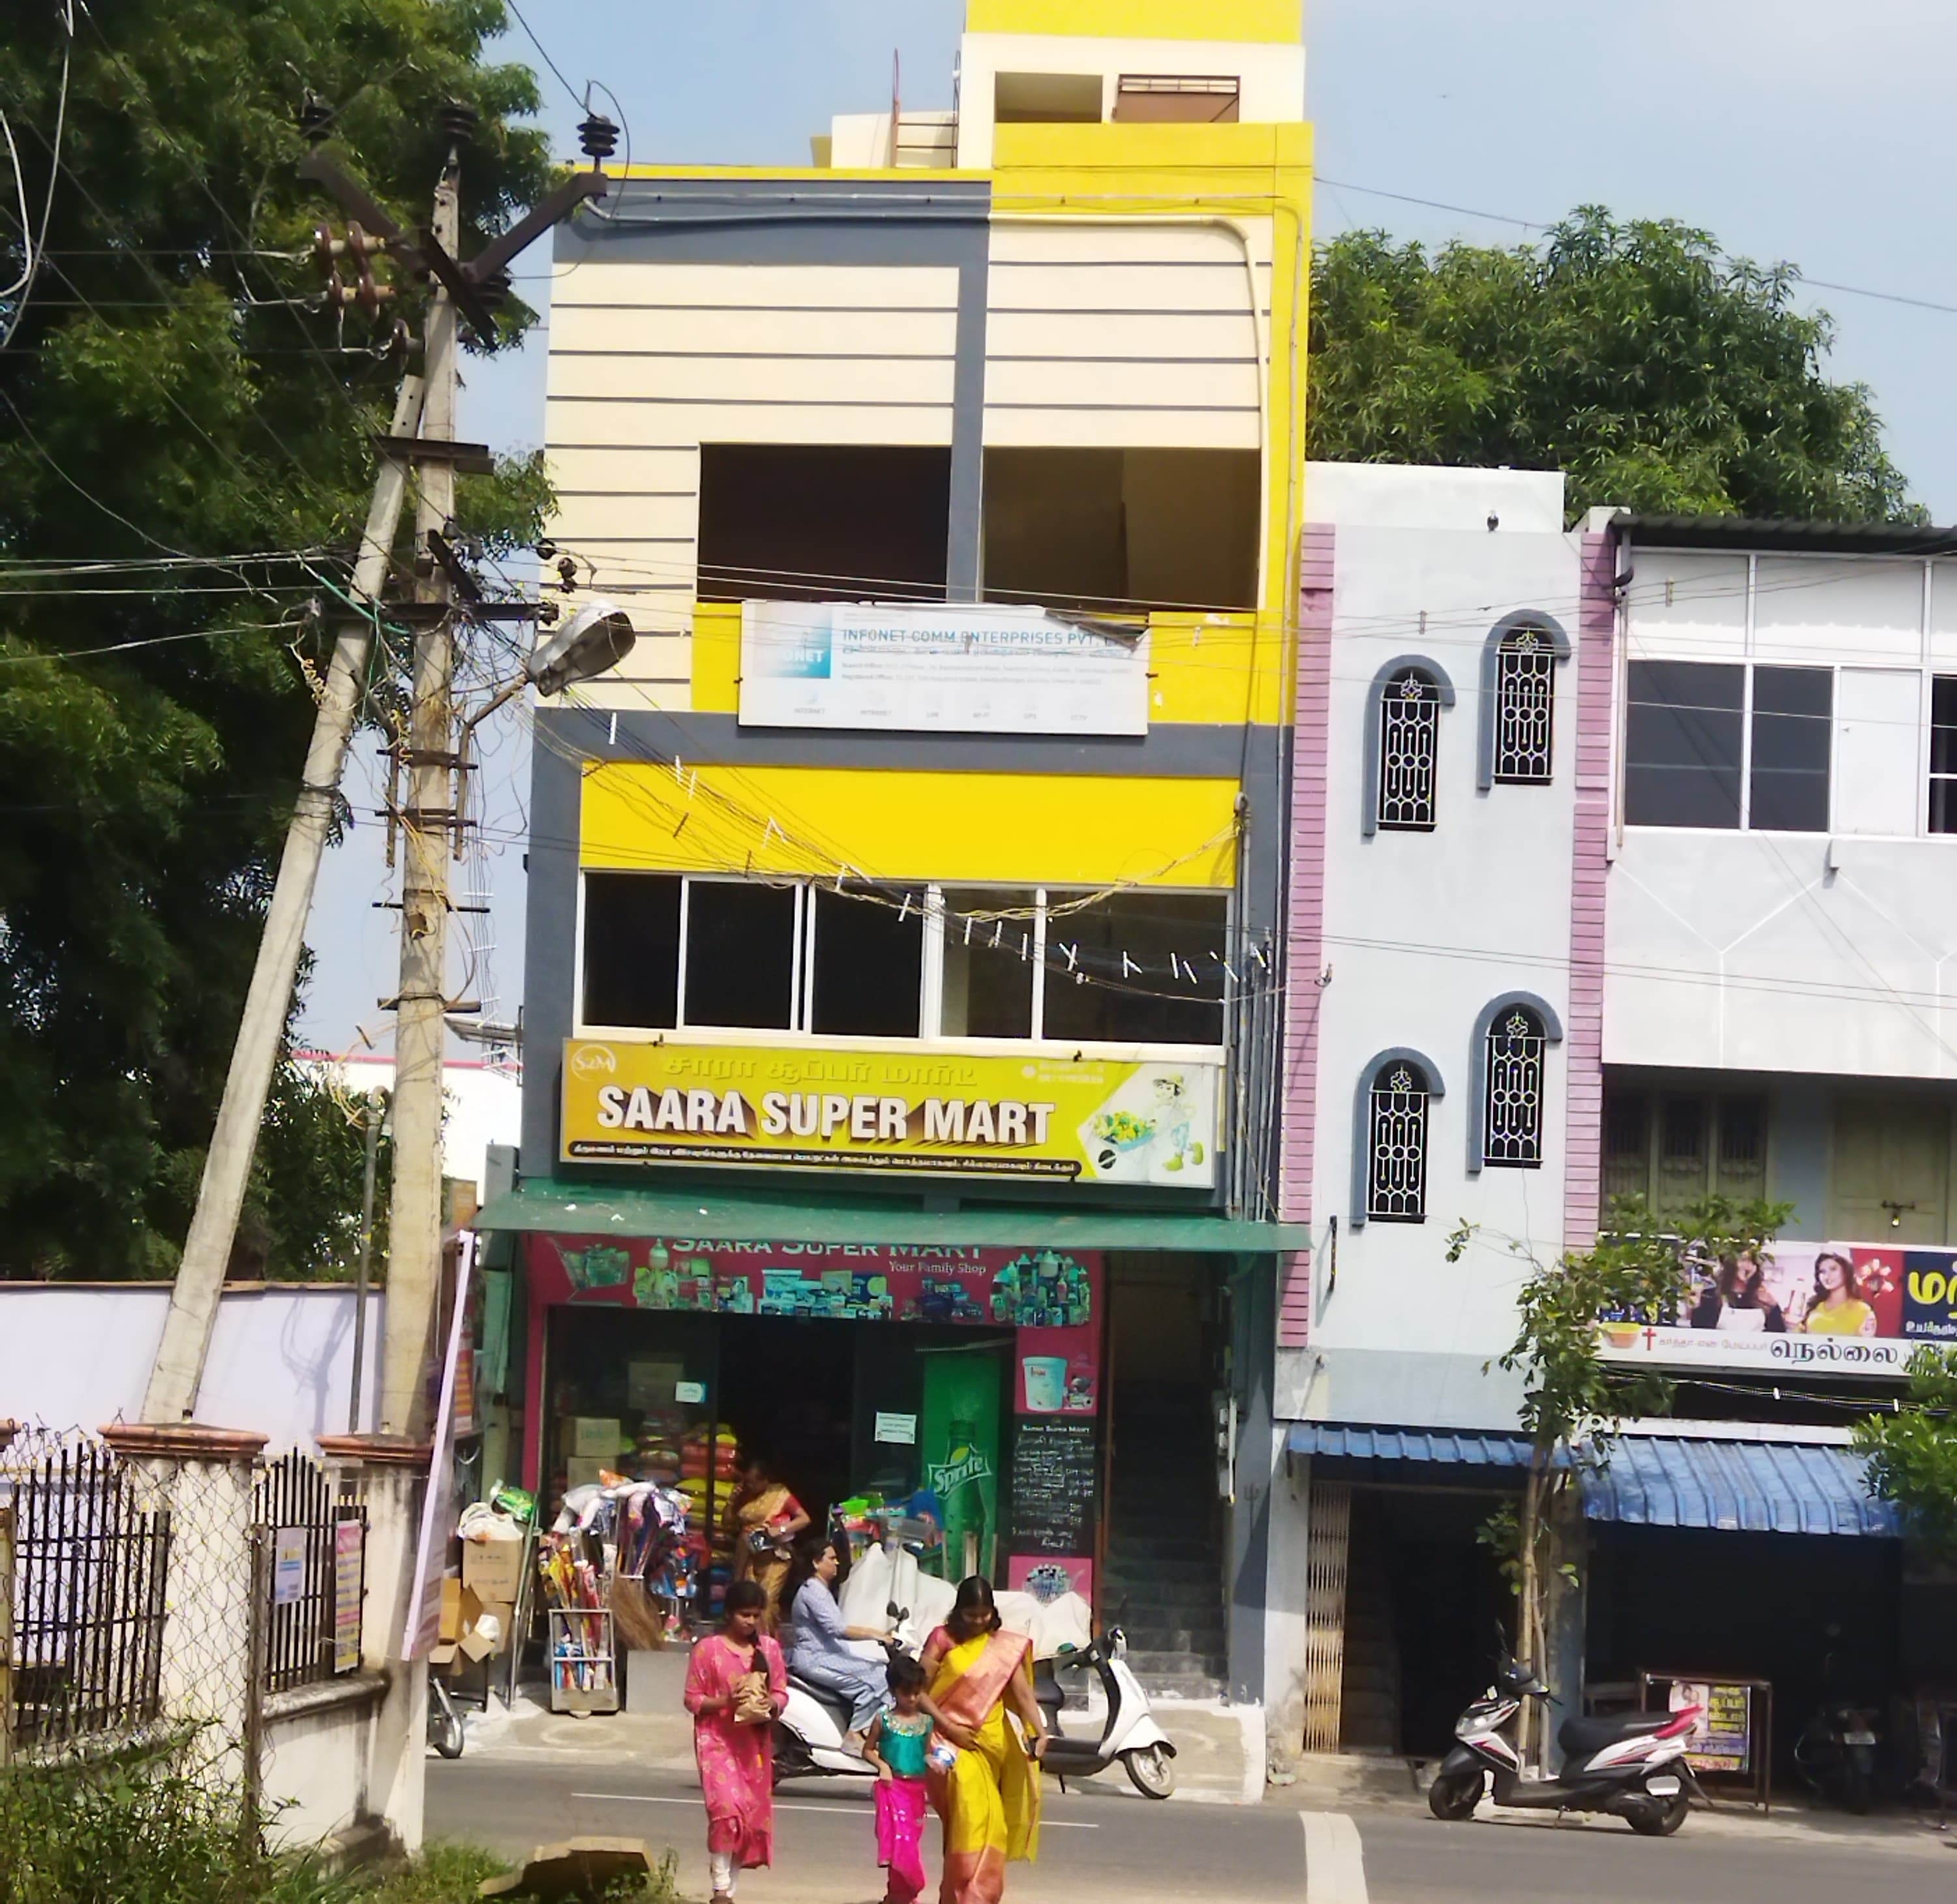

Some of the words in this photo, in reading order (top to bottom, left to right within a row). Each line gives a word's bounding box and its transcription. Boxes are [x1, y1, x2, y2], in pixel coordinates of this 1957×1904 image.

[843, 628, 907, 642] INFONET
[911, 629, 956, 643] COMM
[960, 631, 1063, 644] ENTERPRISES
[596, 1085, 748, 1135] SAARA
[760, 1091, 908, 1140] SUPER
[922, 1098, 1056, 1144] MART
[888, 1260, 915, 1273] Your
[917, 1262, 954, 1275] Family
[958, 1263, 987, 1276] Shop
[1770, 1337, 1898, 1365] நெல்லை
[933, 1453, 984, 1494] Sprite
